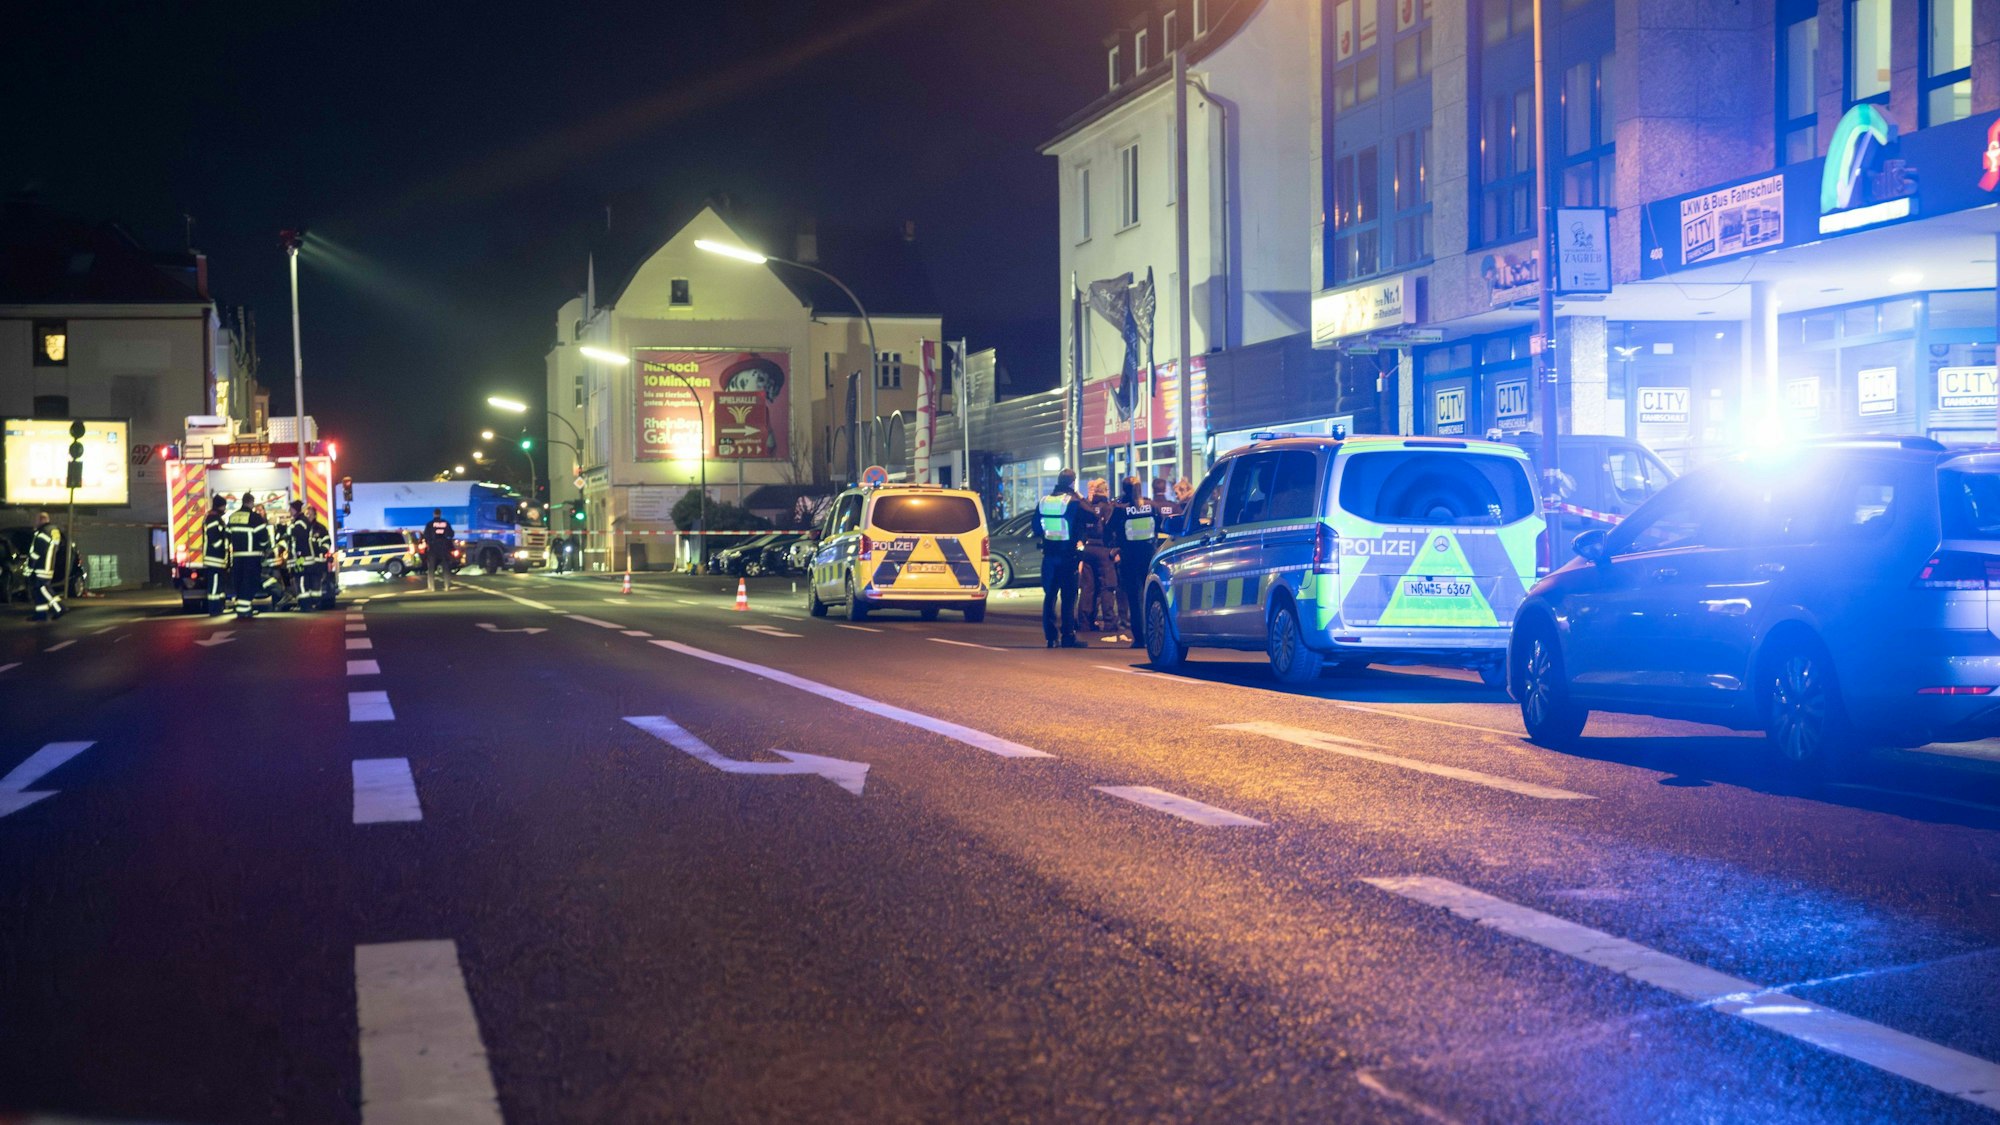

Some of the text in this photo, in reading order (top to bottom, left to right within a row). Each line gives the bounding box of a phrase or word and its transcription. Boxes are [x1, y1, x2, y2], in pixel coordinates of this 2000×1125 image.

[1683, 177, 1782, 217] LKW & Bus Fahrschule
[1686, 216, 1712, 247] CITY
[1564, 253, 1602, 263] ZAGREB
[667, 361, 699, 372] noch
[644, 375, 711, 387] 10 Minuten
[1946, 372, 1998, 393] CITY
[719, 396, 757, 404] SPIELHALLE
[1440, 394, 1464, 421] CITY
[1499, 385, 1526, 414] CITY
[1644, 392, 1685, 411] CITY
[872, 541, 913, 551] POLIZEI
[1340, 539, 1416, 556] POLIZEI
[1411, 583, 1471, 596] NRW 5-6367
